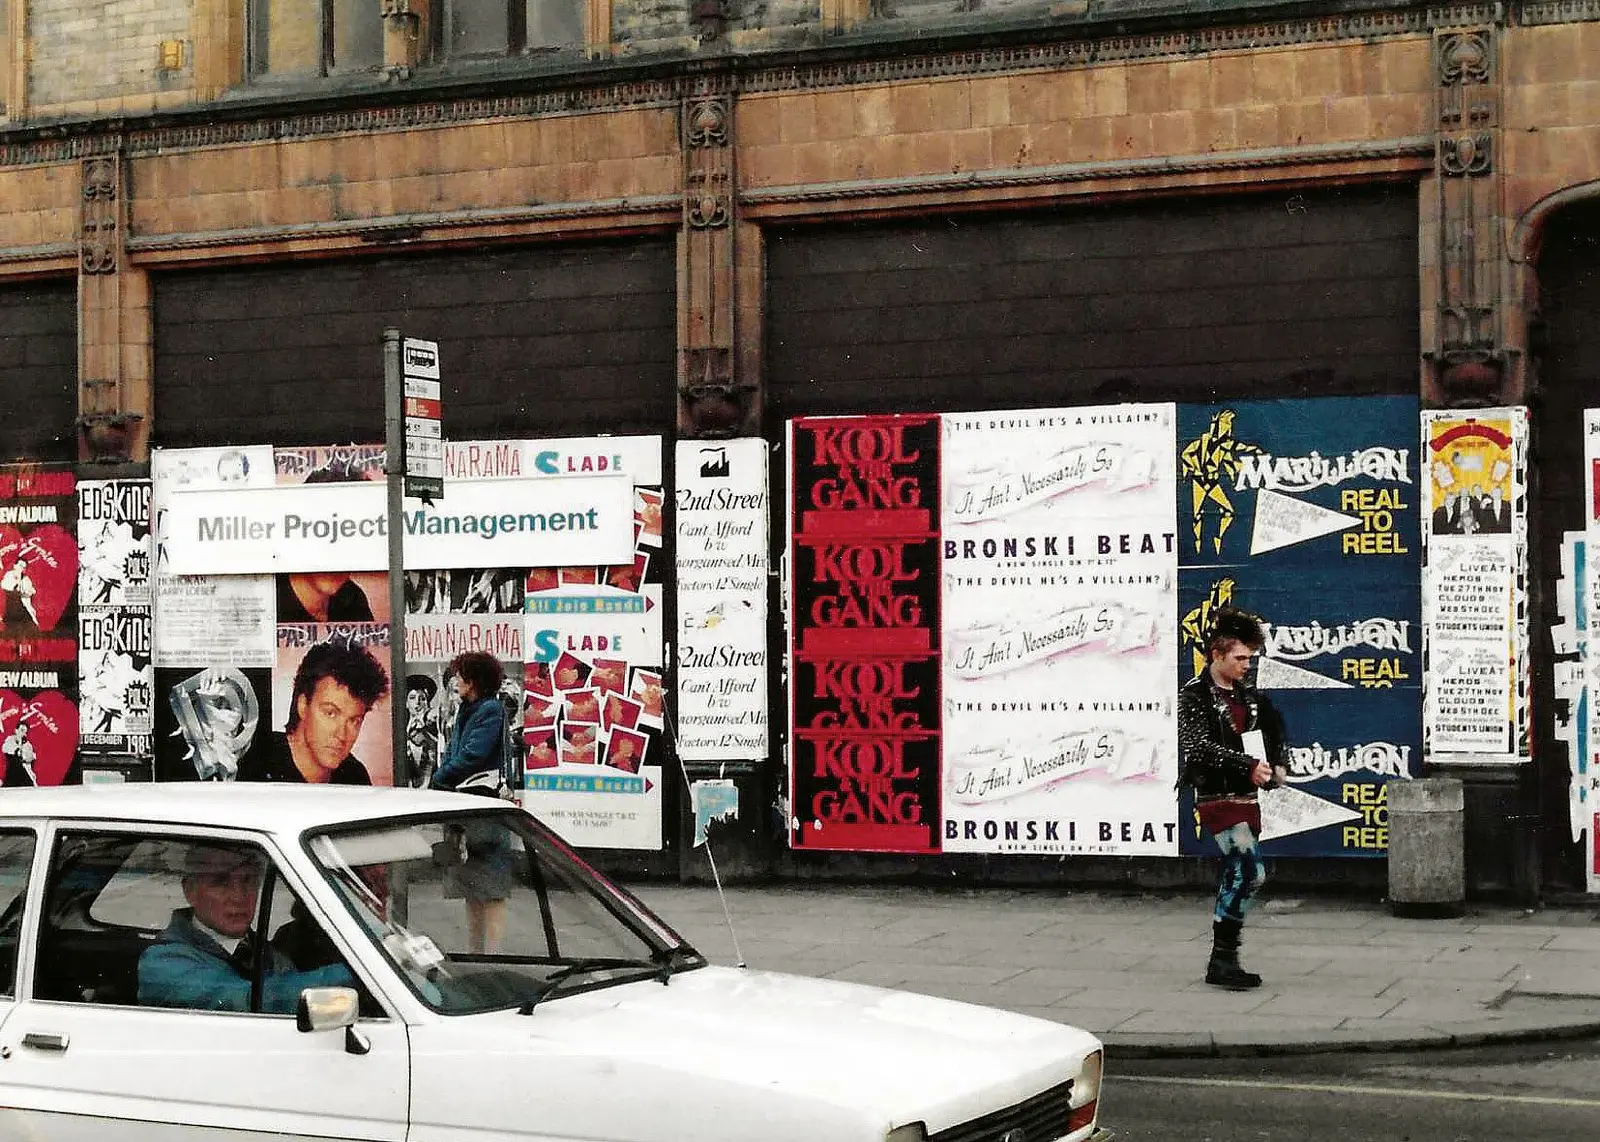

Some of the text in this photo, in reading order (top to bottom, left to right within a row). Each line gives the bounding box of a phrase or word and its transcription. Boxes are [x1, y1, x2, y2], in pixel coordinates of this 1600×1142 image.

[956, 413, 1158, 431] THE DEVIL HE'S A VILLAIN?
[1017, 455, 1087, 501] Necessarily
[714, 487, 764, 510] Street
[811, 478, 921, 510] GANG
[1341, 489, 1408, 511] REAL
[199, 507, 599, 543] Miller Project Management
[1360, 510, 1393, 532] TO
[944, 533, 1174, 559] BRONSKI BEAT
[1342, 532, 1408, 554] REEL
[957, 575, 1160, 586] THE DEVIL HE'S A VILLAIN?
[811, 595, 921, 628] GANG
[534, 629, 623, 663] SLADE
[955, 646, 975, 670] It
[1017, 613, 1088, 659] Necessarily
[1093, 608, 1114, 633] So
[716, 644, 765, 668] Street
[1342, 658, 1409, 679] REAL
[1459, 666, 1487, 675] LIVE
[957, 701, 1160, 711] THE DEVIL HE'S A VILLAIN?
[956, 772, 975, 794] It
[1018, 738, 1089, 785] Necessarily
[1093, 735, 1114, 759] So
[1285, 741, 1413, 783] RILLION
[812, 790, 922, 824] GANG
[945, 820, 1175, 843] BRONSKI BEAT
